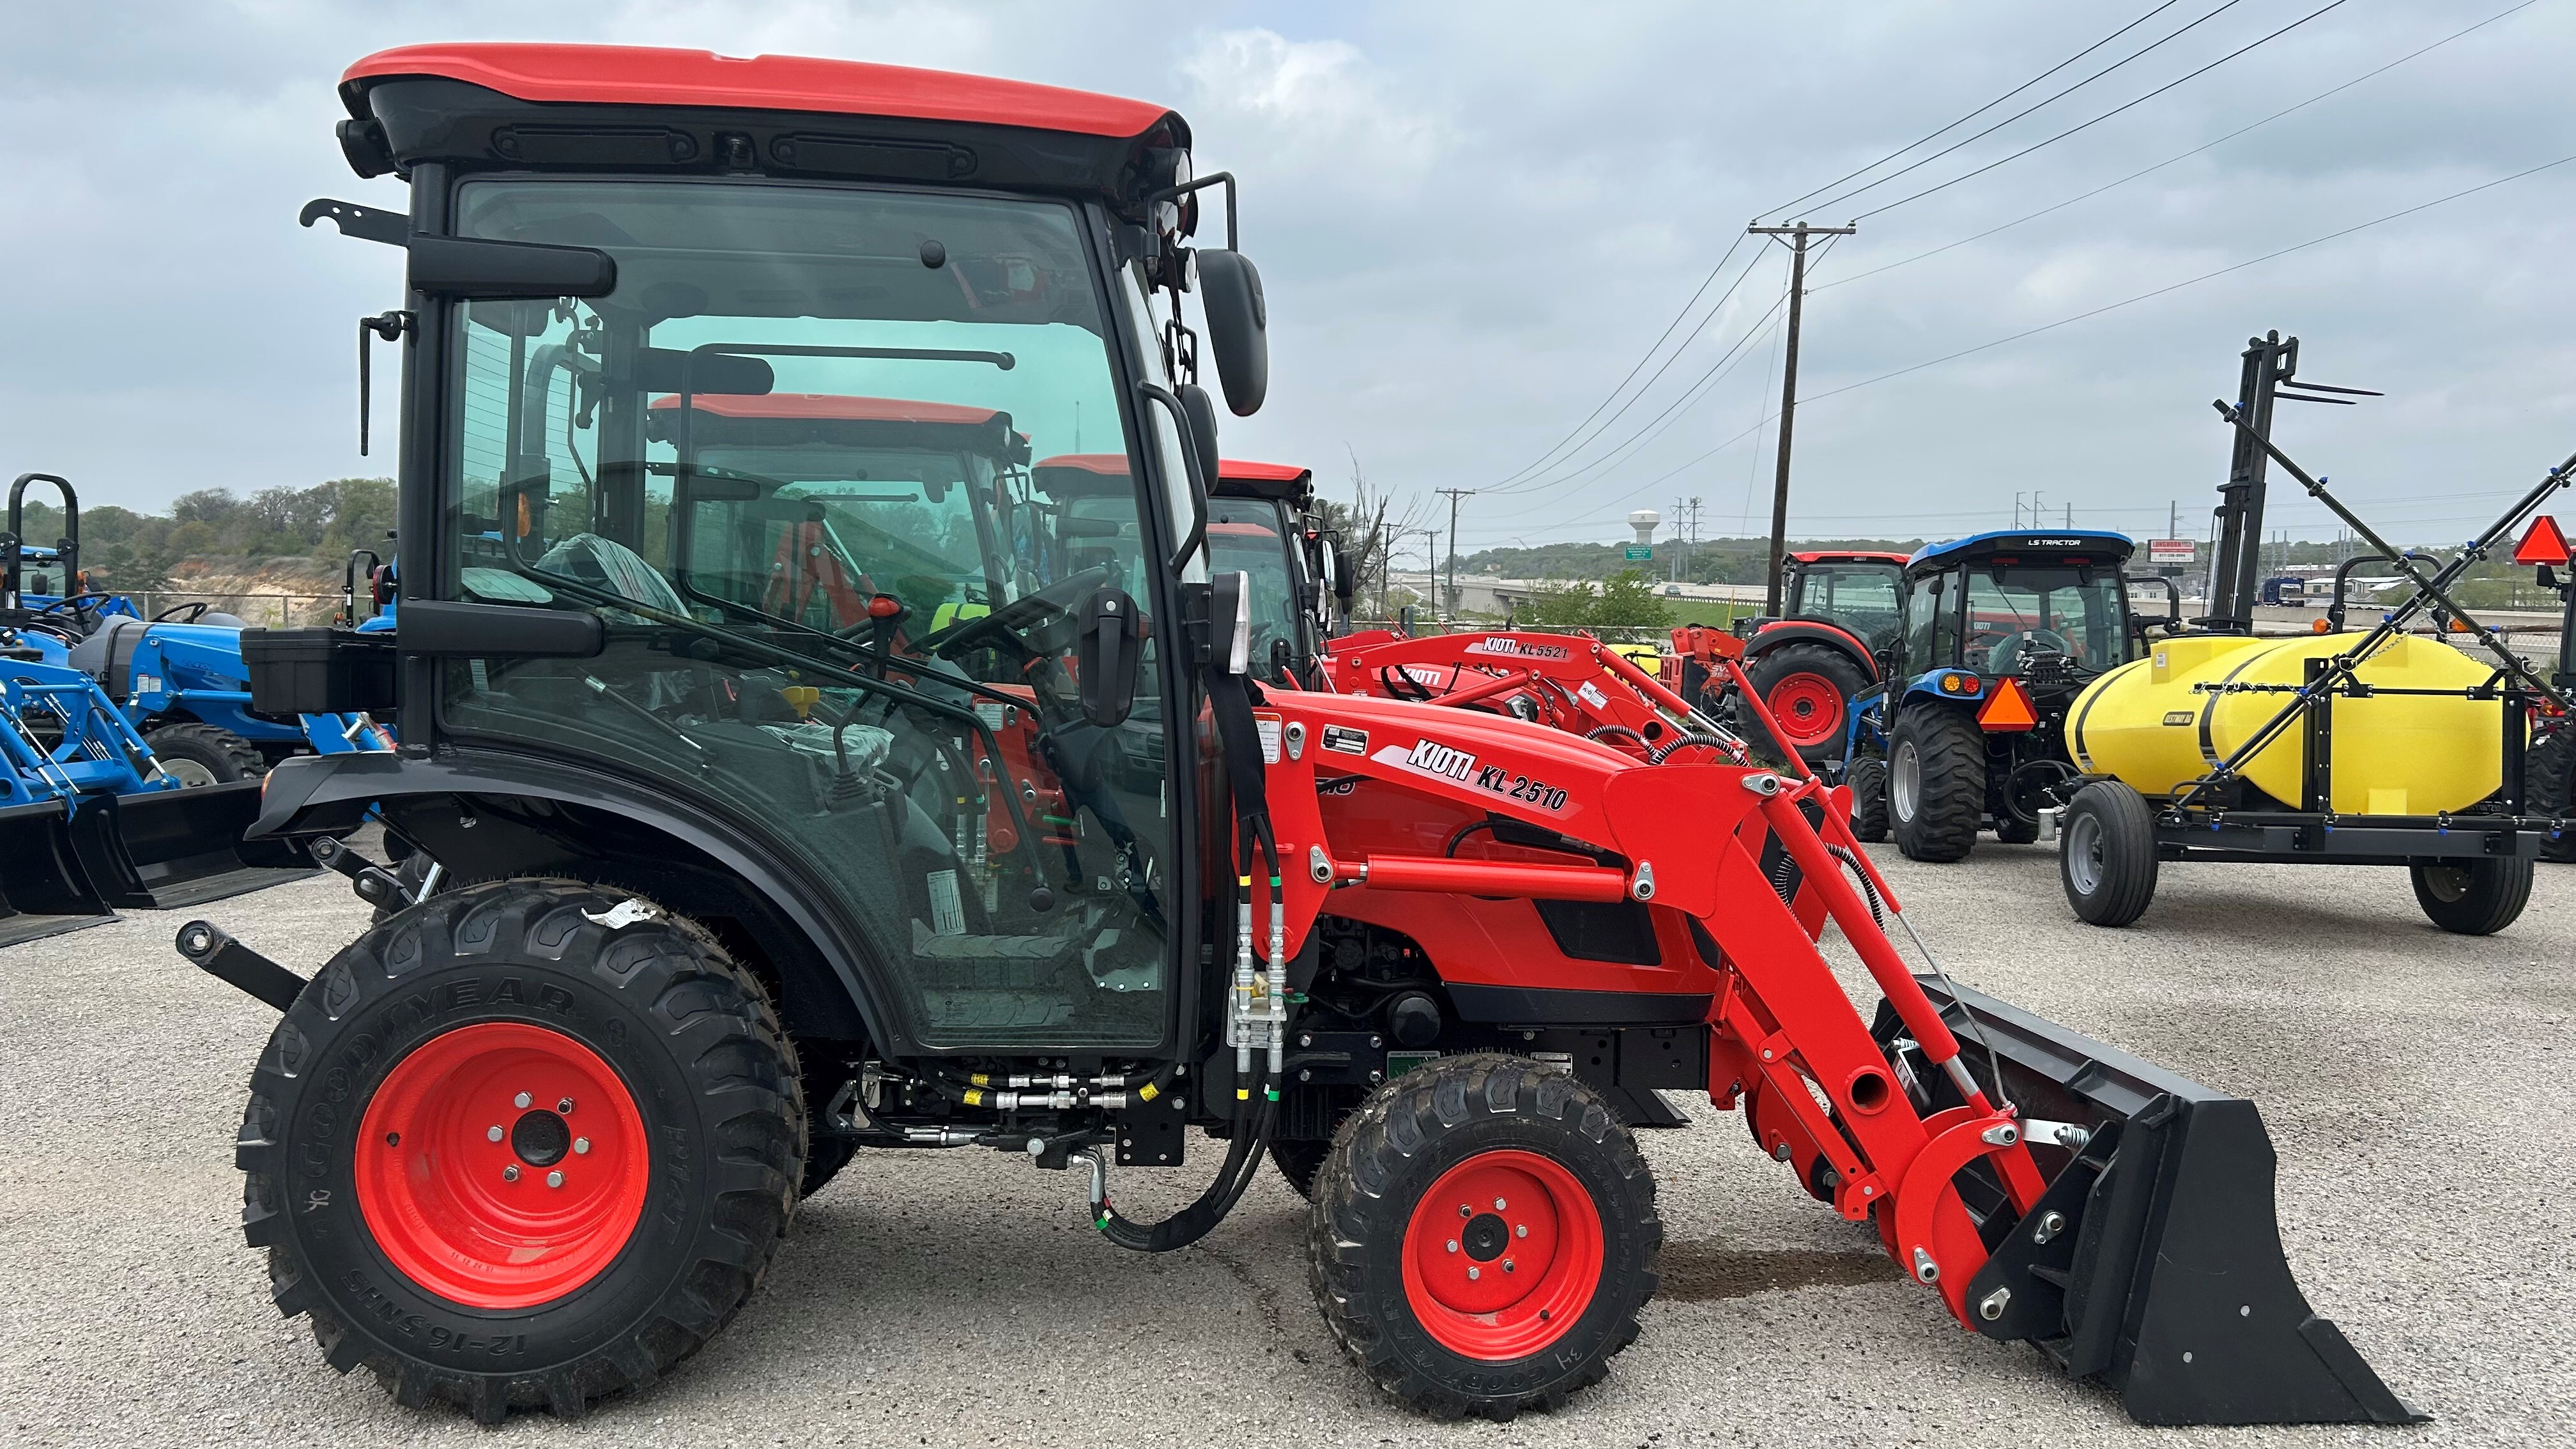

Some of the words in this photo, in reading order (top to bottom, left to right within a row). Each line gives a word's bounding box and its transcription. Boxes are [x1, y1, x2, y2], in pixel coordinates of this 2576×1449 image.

[1482, 636, 1517, 654] KIOTI
[1519, 642, 1535, 656] KL
[1536, 645, 1569, 659] 5521
[1406, 737, 1477, 781] KIOTI
[1475, 764, 1508, 794] KL
[1508, 774, 1568, 812] 2510
[300, 976, 576, 1178] GOODYEAR
[341, 1268, 528, 1356] 12-16.5NHS
[1382, 1297, 1547, 1391] GOODYEAR
